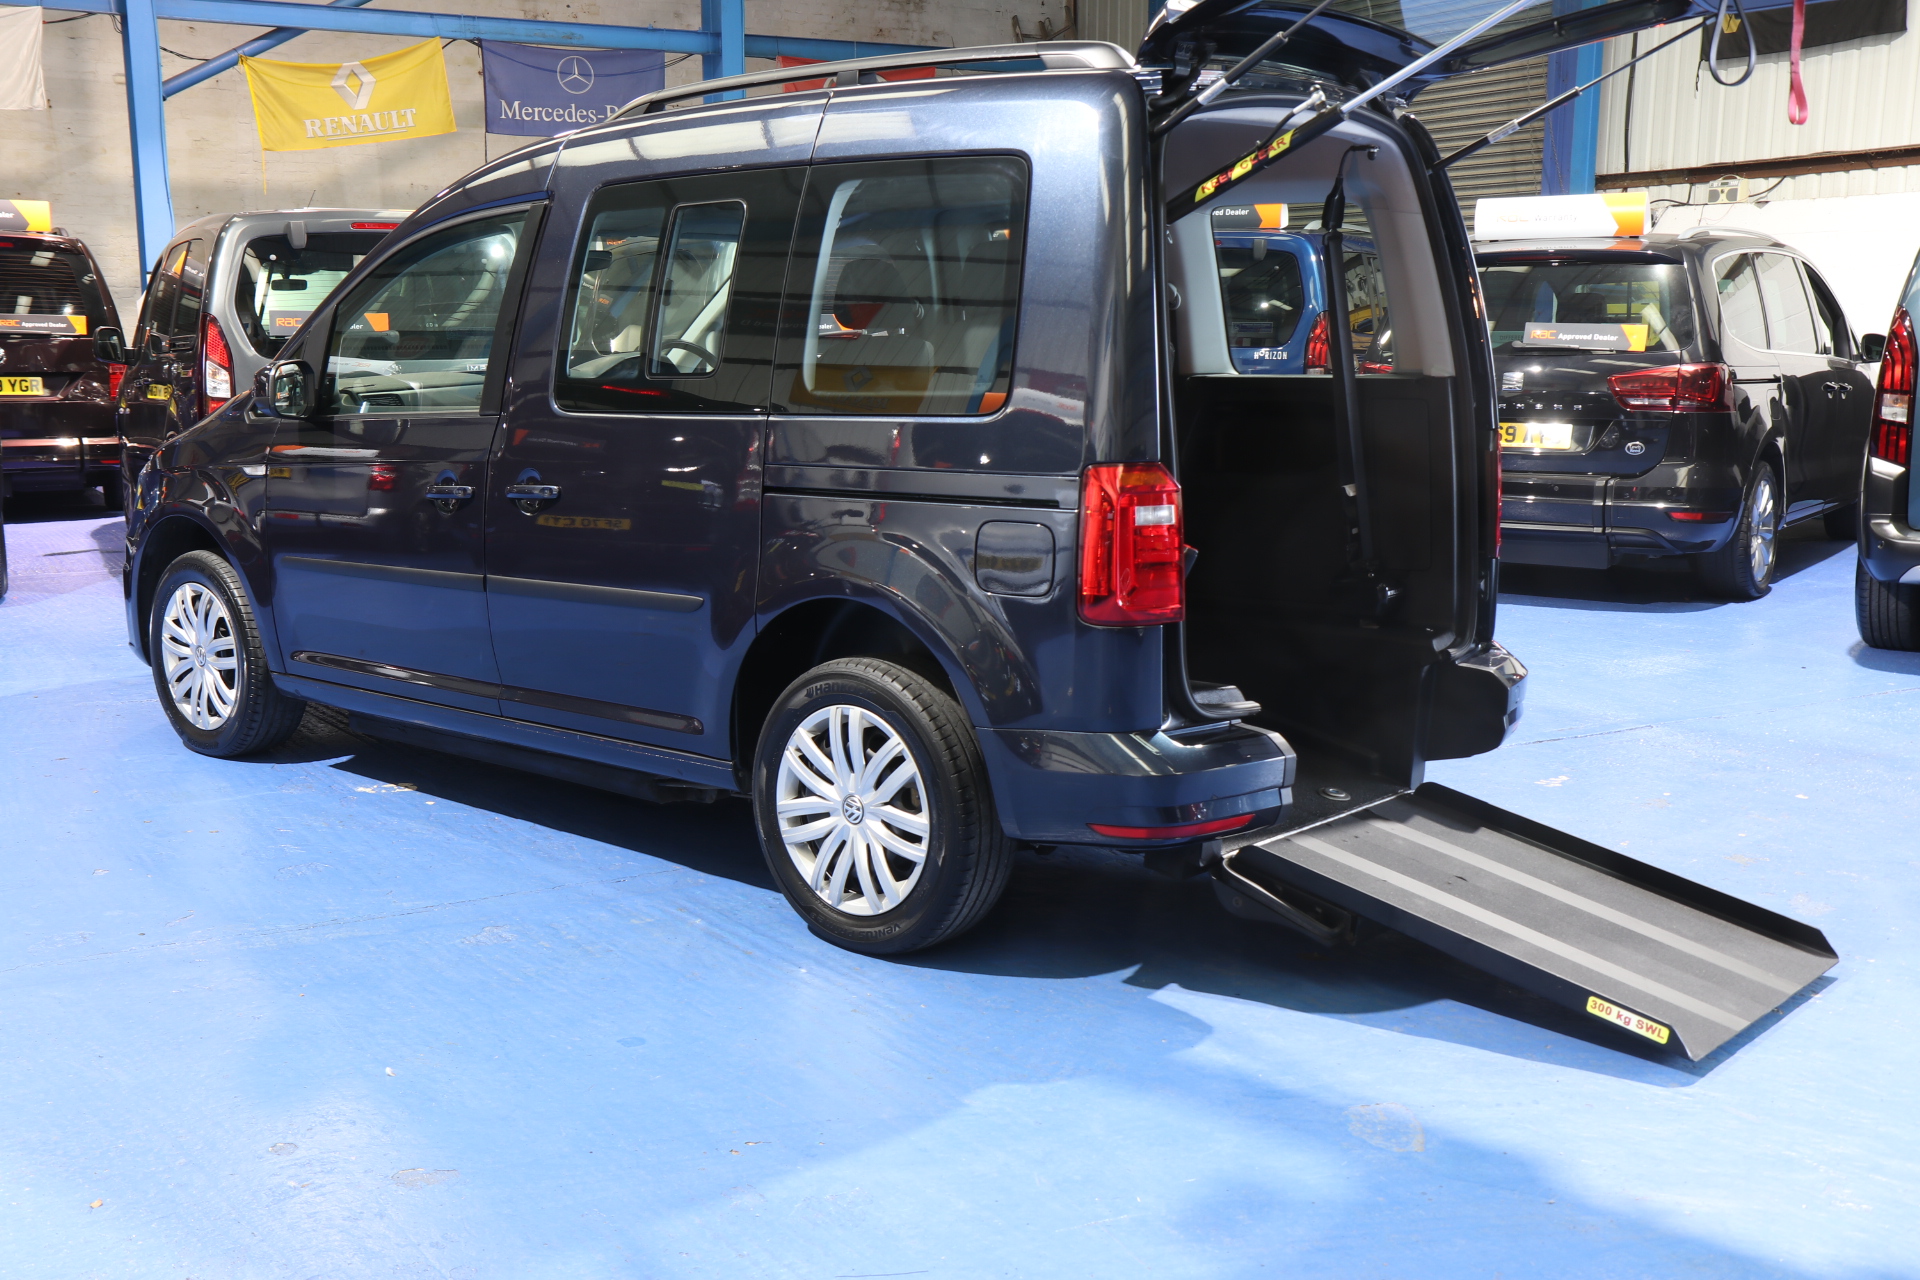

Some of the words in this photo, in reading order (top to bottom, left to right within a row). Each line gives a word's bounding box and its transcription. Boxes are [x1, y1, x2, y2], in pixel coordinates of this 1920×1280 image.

[303, 108, 416, 138] RENAULT
[1201, 167, 1235, 194] KEEP
[1240, 137, 1287, 170] CLEAR
[1225, 208, 1249, 216] Dealer
[21, 320, 48, 329] Approved
[1558, 332, 1592, 342] Approved
[1593, 332, 1619, 342] Dealer
[1254, 349, 1288, 360] HORIZON
[8, 379, 41, 392] YGR
[1590, 999, 1612, 1016] 300
[1616, 1010, 1632, 1027] kg
[1636, 1019, 1665, 1040] SWL
